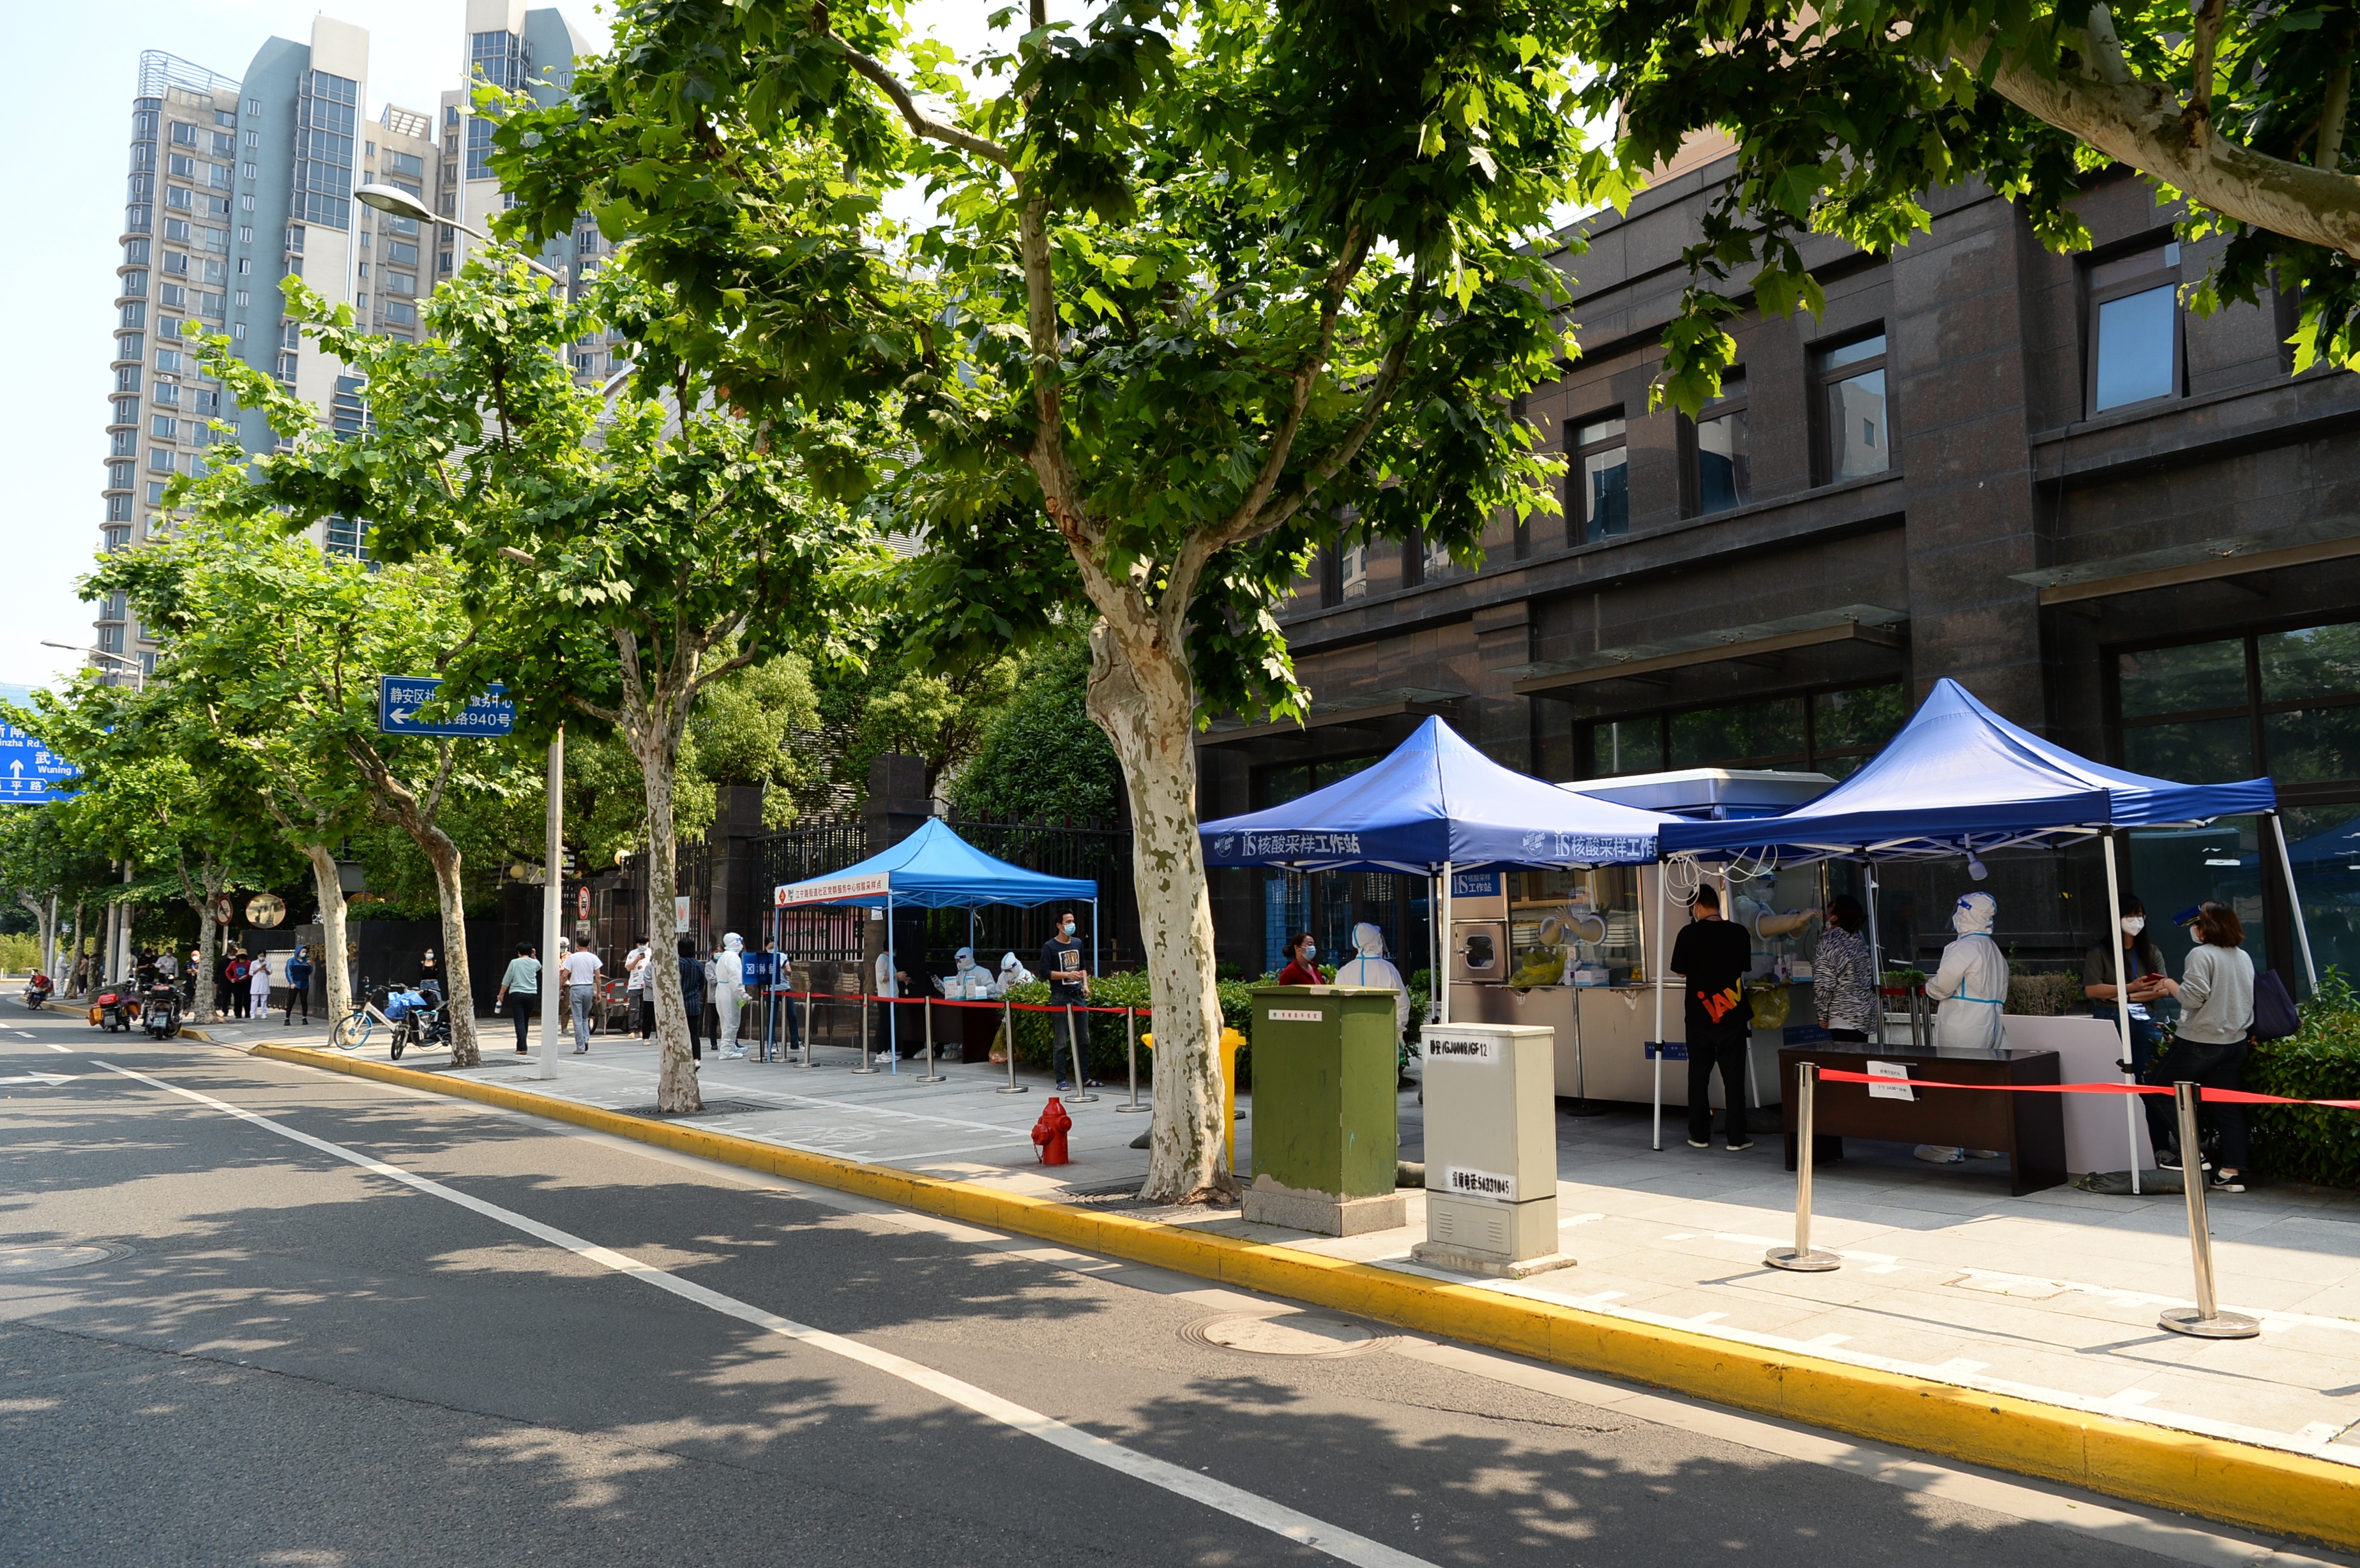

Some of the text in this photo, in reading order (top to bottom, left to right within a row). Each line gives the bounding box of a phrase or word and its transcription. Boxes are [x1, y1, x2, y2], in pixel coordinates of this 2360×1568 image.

[0, 738, 24, 747] inzha
[38, 765, 72, 776] Wuning
[0, 780, 42, 791] 平路
[1257, 834, 1361, 855] 核酸采样工作站
[1469, 882, 1492, 893] 工作站
